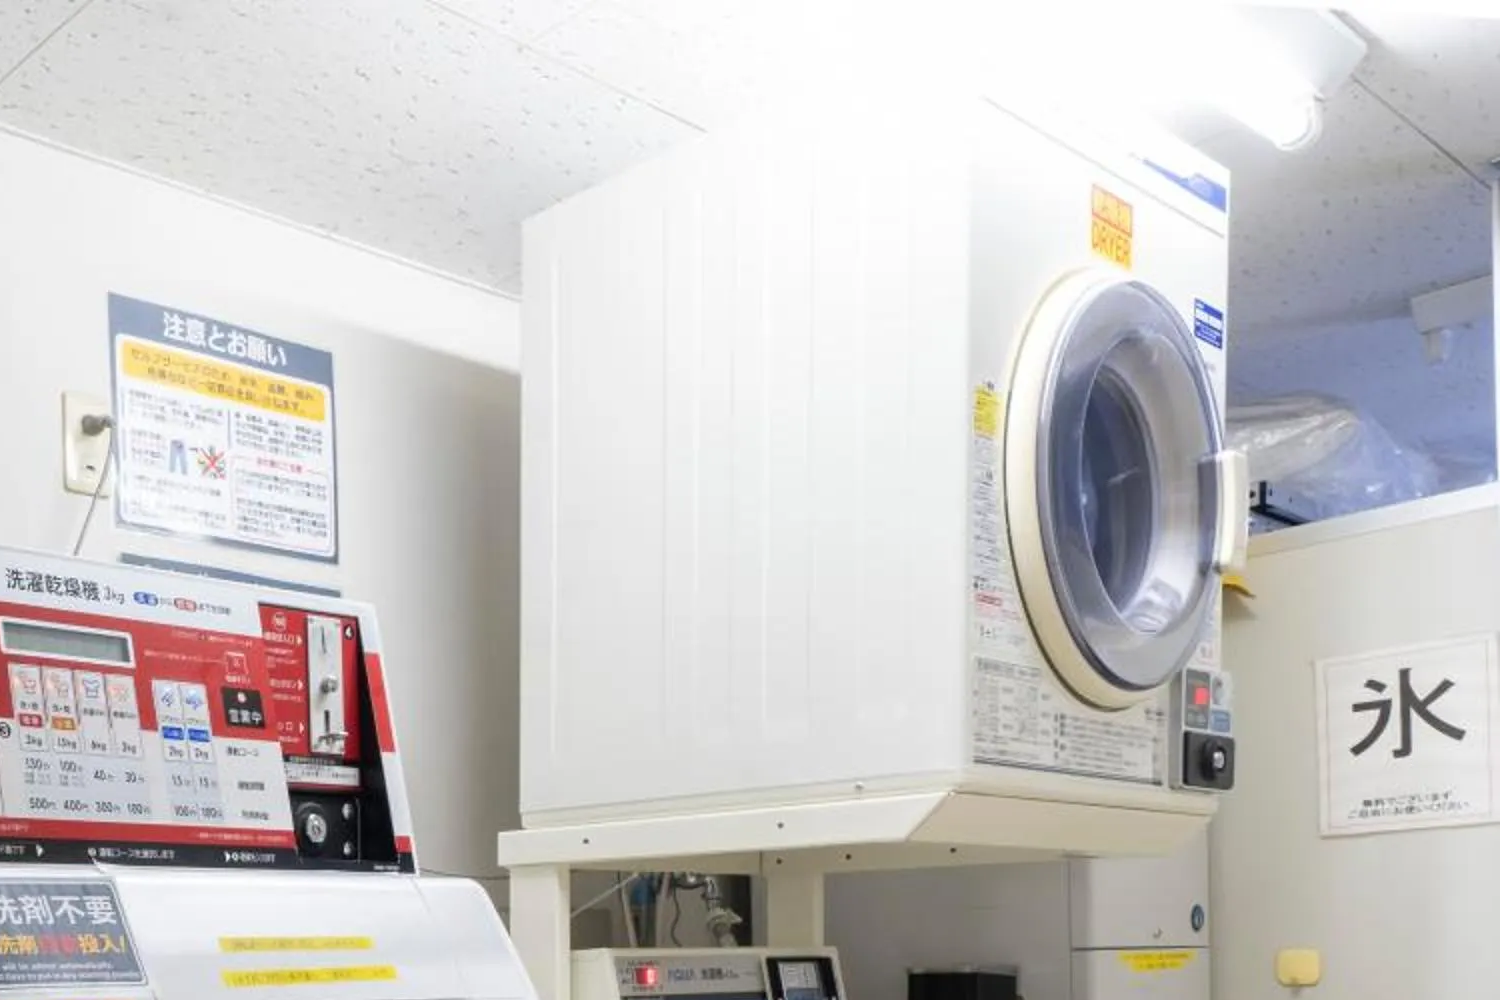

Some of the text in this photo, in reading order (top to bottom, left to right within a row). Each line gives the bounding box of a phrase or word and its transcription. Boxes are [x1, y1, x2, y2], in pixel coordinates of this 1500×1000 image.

[163, 311, 287, 366] 注意とお願い
[5, 567, 100, 602] 洗濯乾燥機
[1350, 667, 1467, 759] 氷
